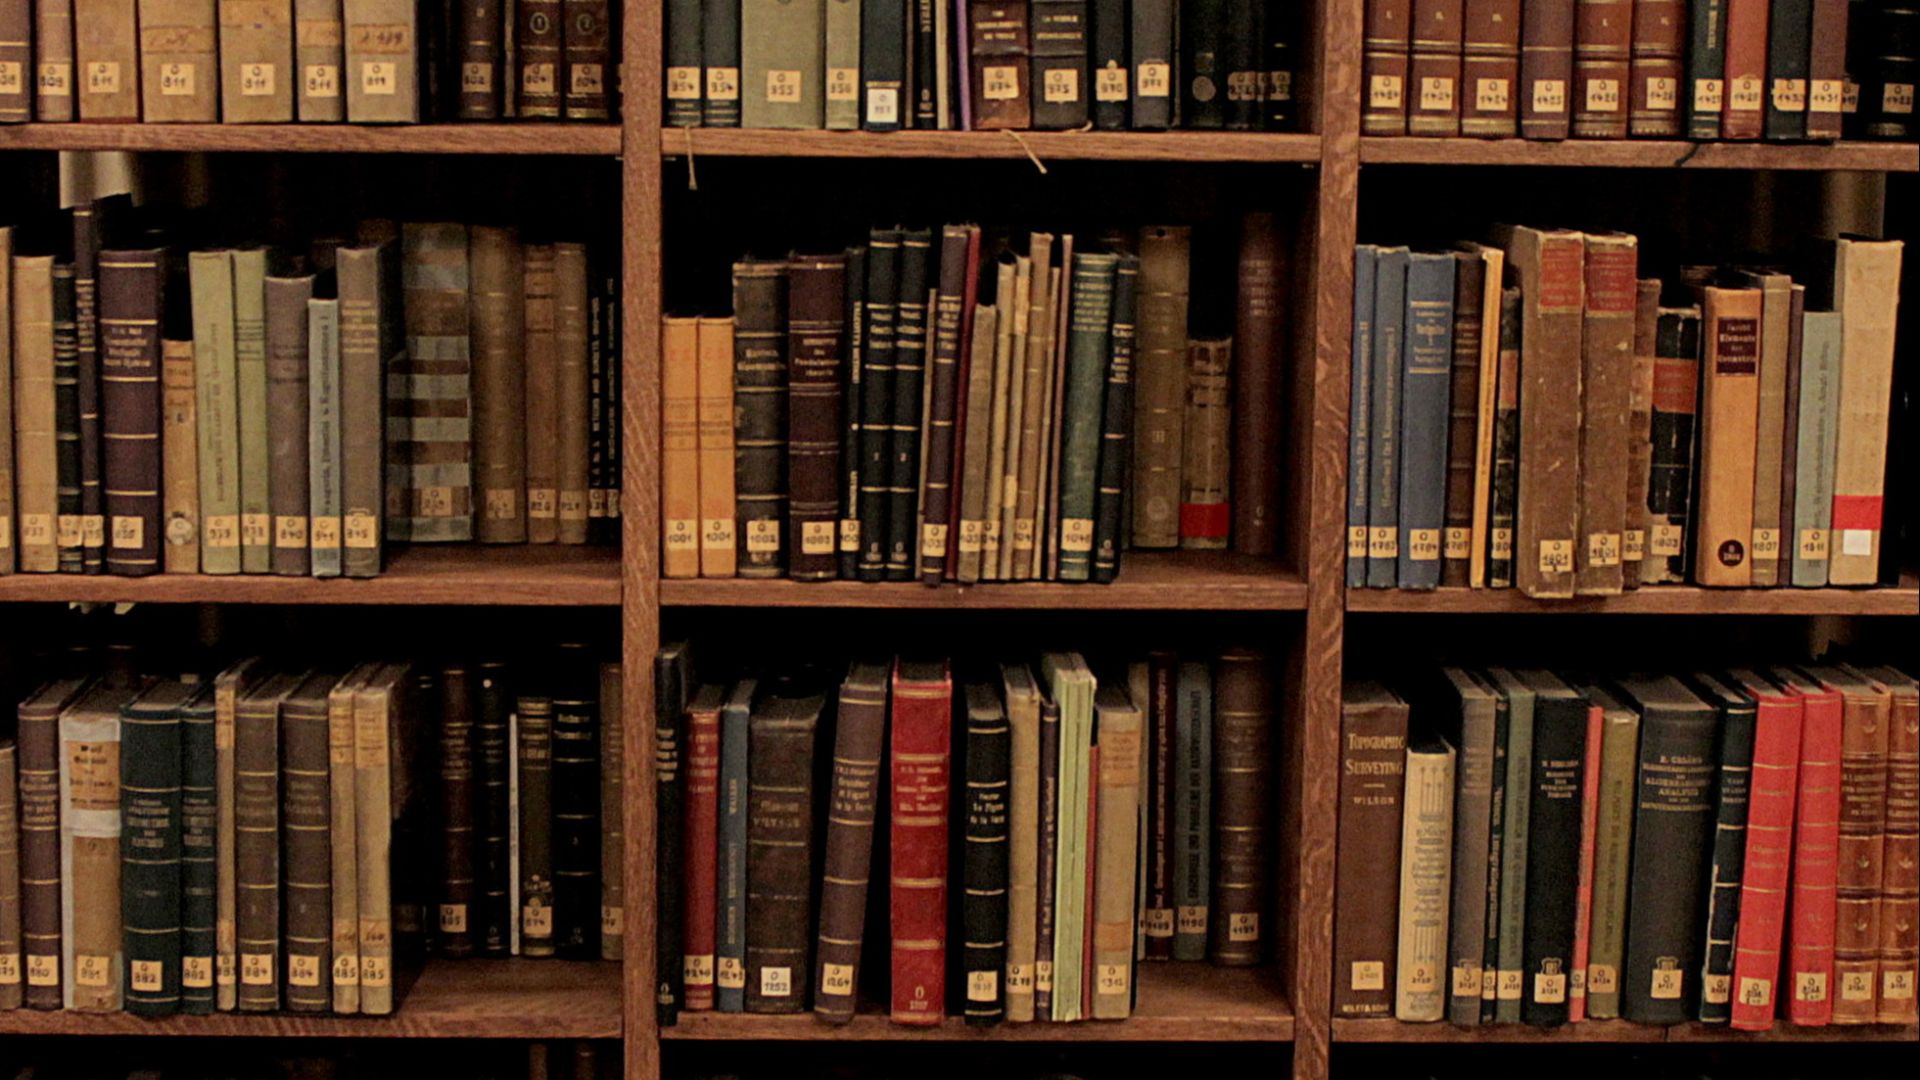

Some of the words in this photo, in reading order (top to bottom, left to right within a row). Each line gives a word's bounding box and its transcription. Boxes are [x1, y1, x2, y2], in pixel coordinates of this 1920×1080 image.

[1348, 732, 1404, 751] TOPOGRAPHIC
[1345, 758, 1402, 776] SURVEYING
[1353, 796, 1395, 805] WILSON
